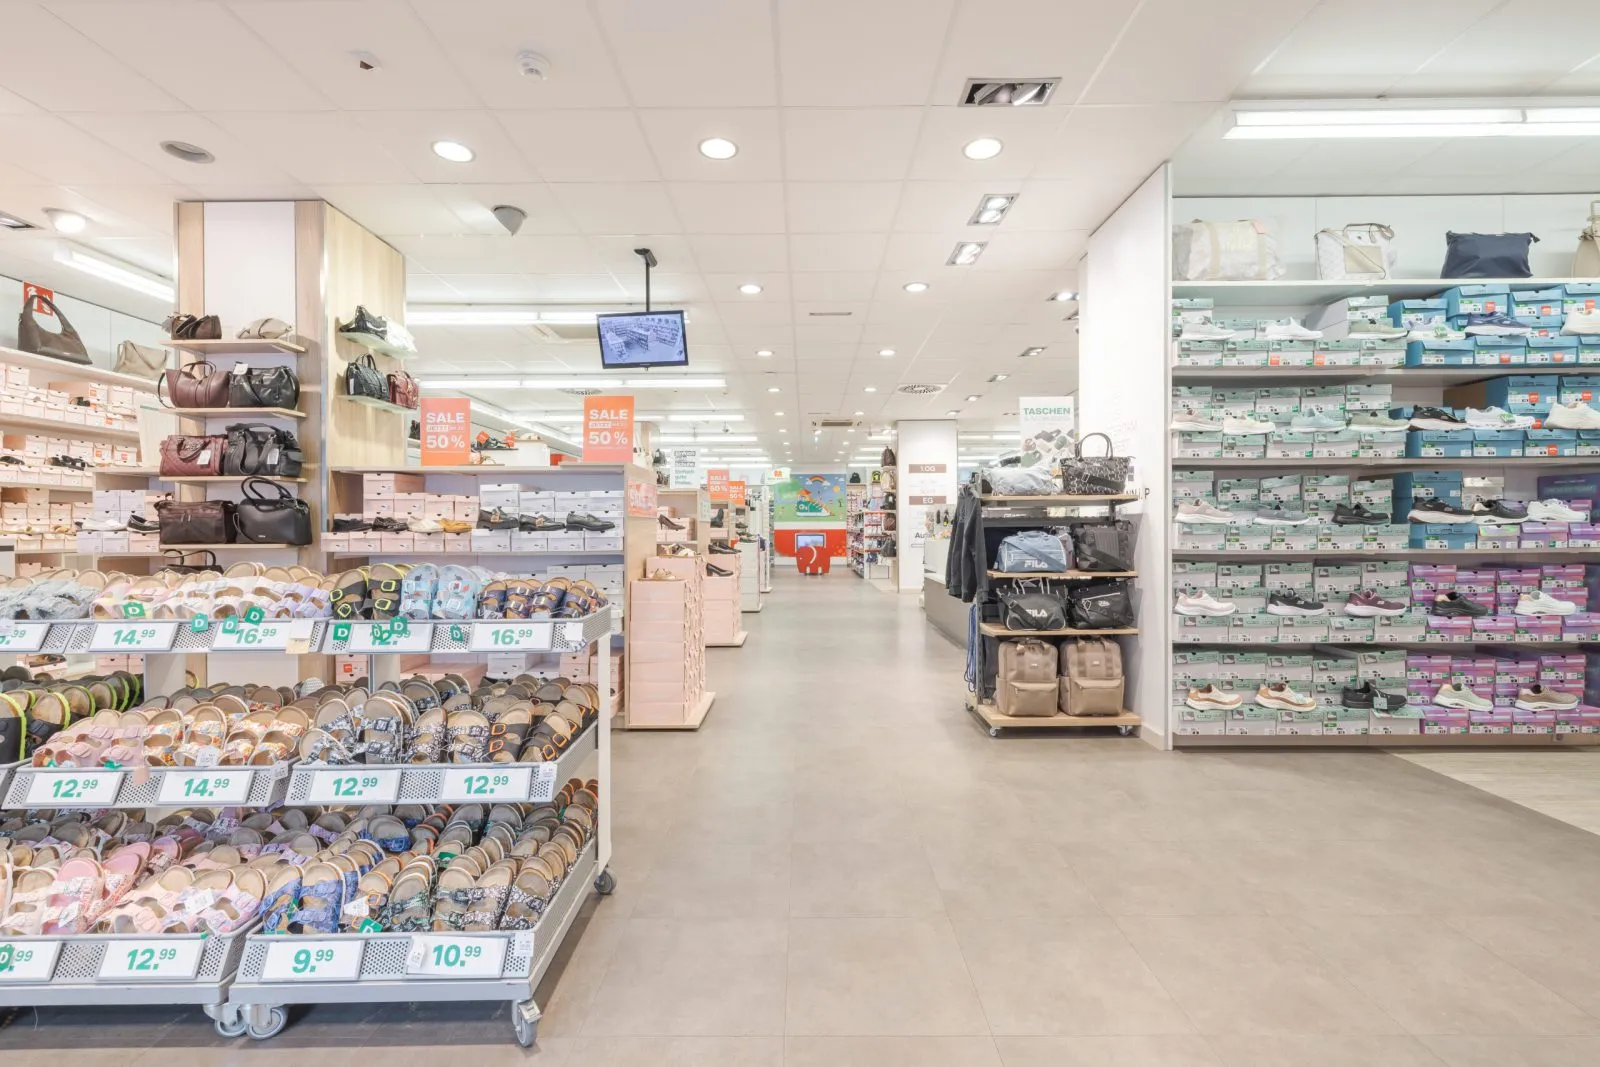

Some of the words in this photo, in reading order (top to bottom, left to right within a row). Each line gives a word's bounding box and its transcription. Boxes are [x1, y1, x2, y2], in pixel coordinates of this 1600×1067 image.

[426, 412, 465, 423] SALE
[589, 409, 629, 420] SALE
[1023, 407, 1071, 415] TASCHEN
[426, 434, 449, 449] 50
[451, 435, 465, 449] %
[588, 431, 611, 445] 50
[615, 431, 628, 445] %
[1025, 560, 1048, 568] FILA
[0, 629, 26, 645] .99
[113, 628, 156, 645] 14.99
[235, 628, 277, 645] 16.99
[491, 629, 533, 645] 16.99
[53, 779, 99, 798] 12.99
[184, 778, 230, 797] 14.99
[332, 777, 378, 797] 12.99
[463, 775, 509, 795] 12.99
[126, 947, 176, 971] 12.99
[291, 949, 334, 974] 9.99
[431, 944, 481, 967] 10.99
